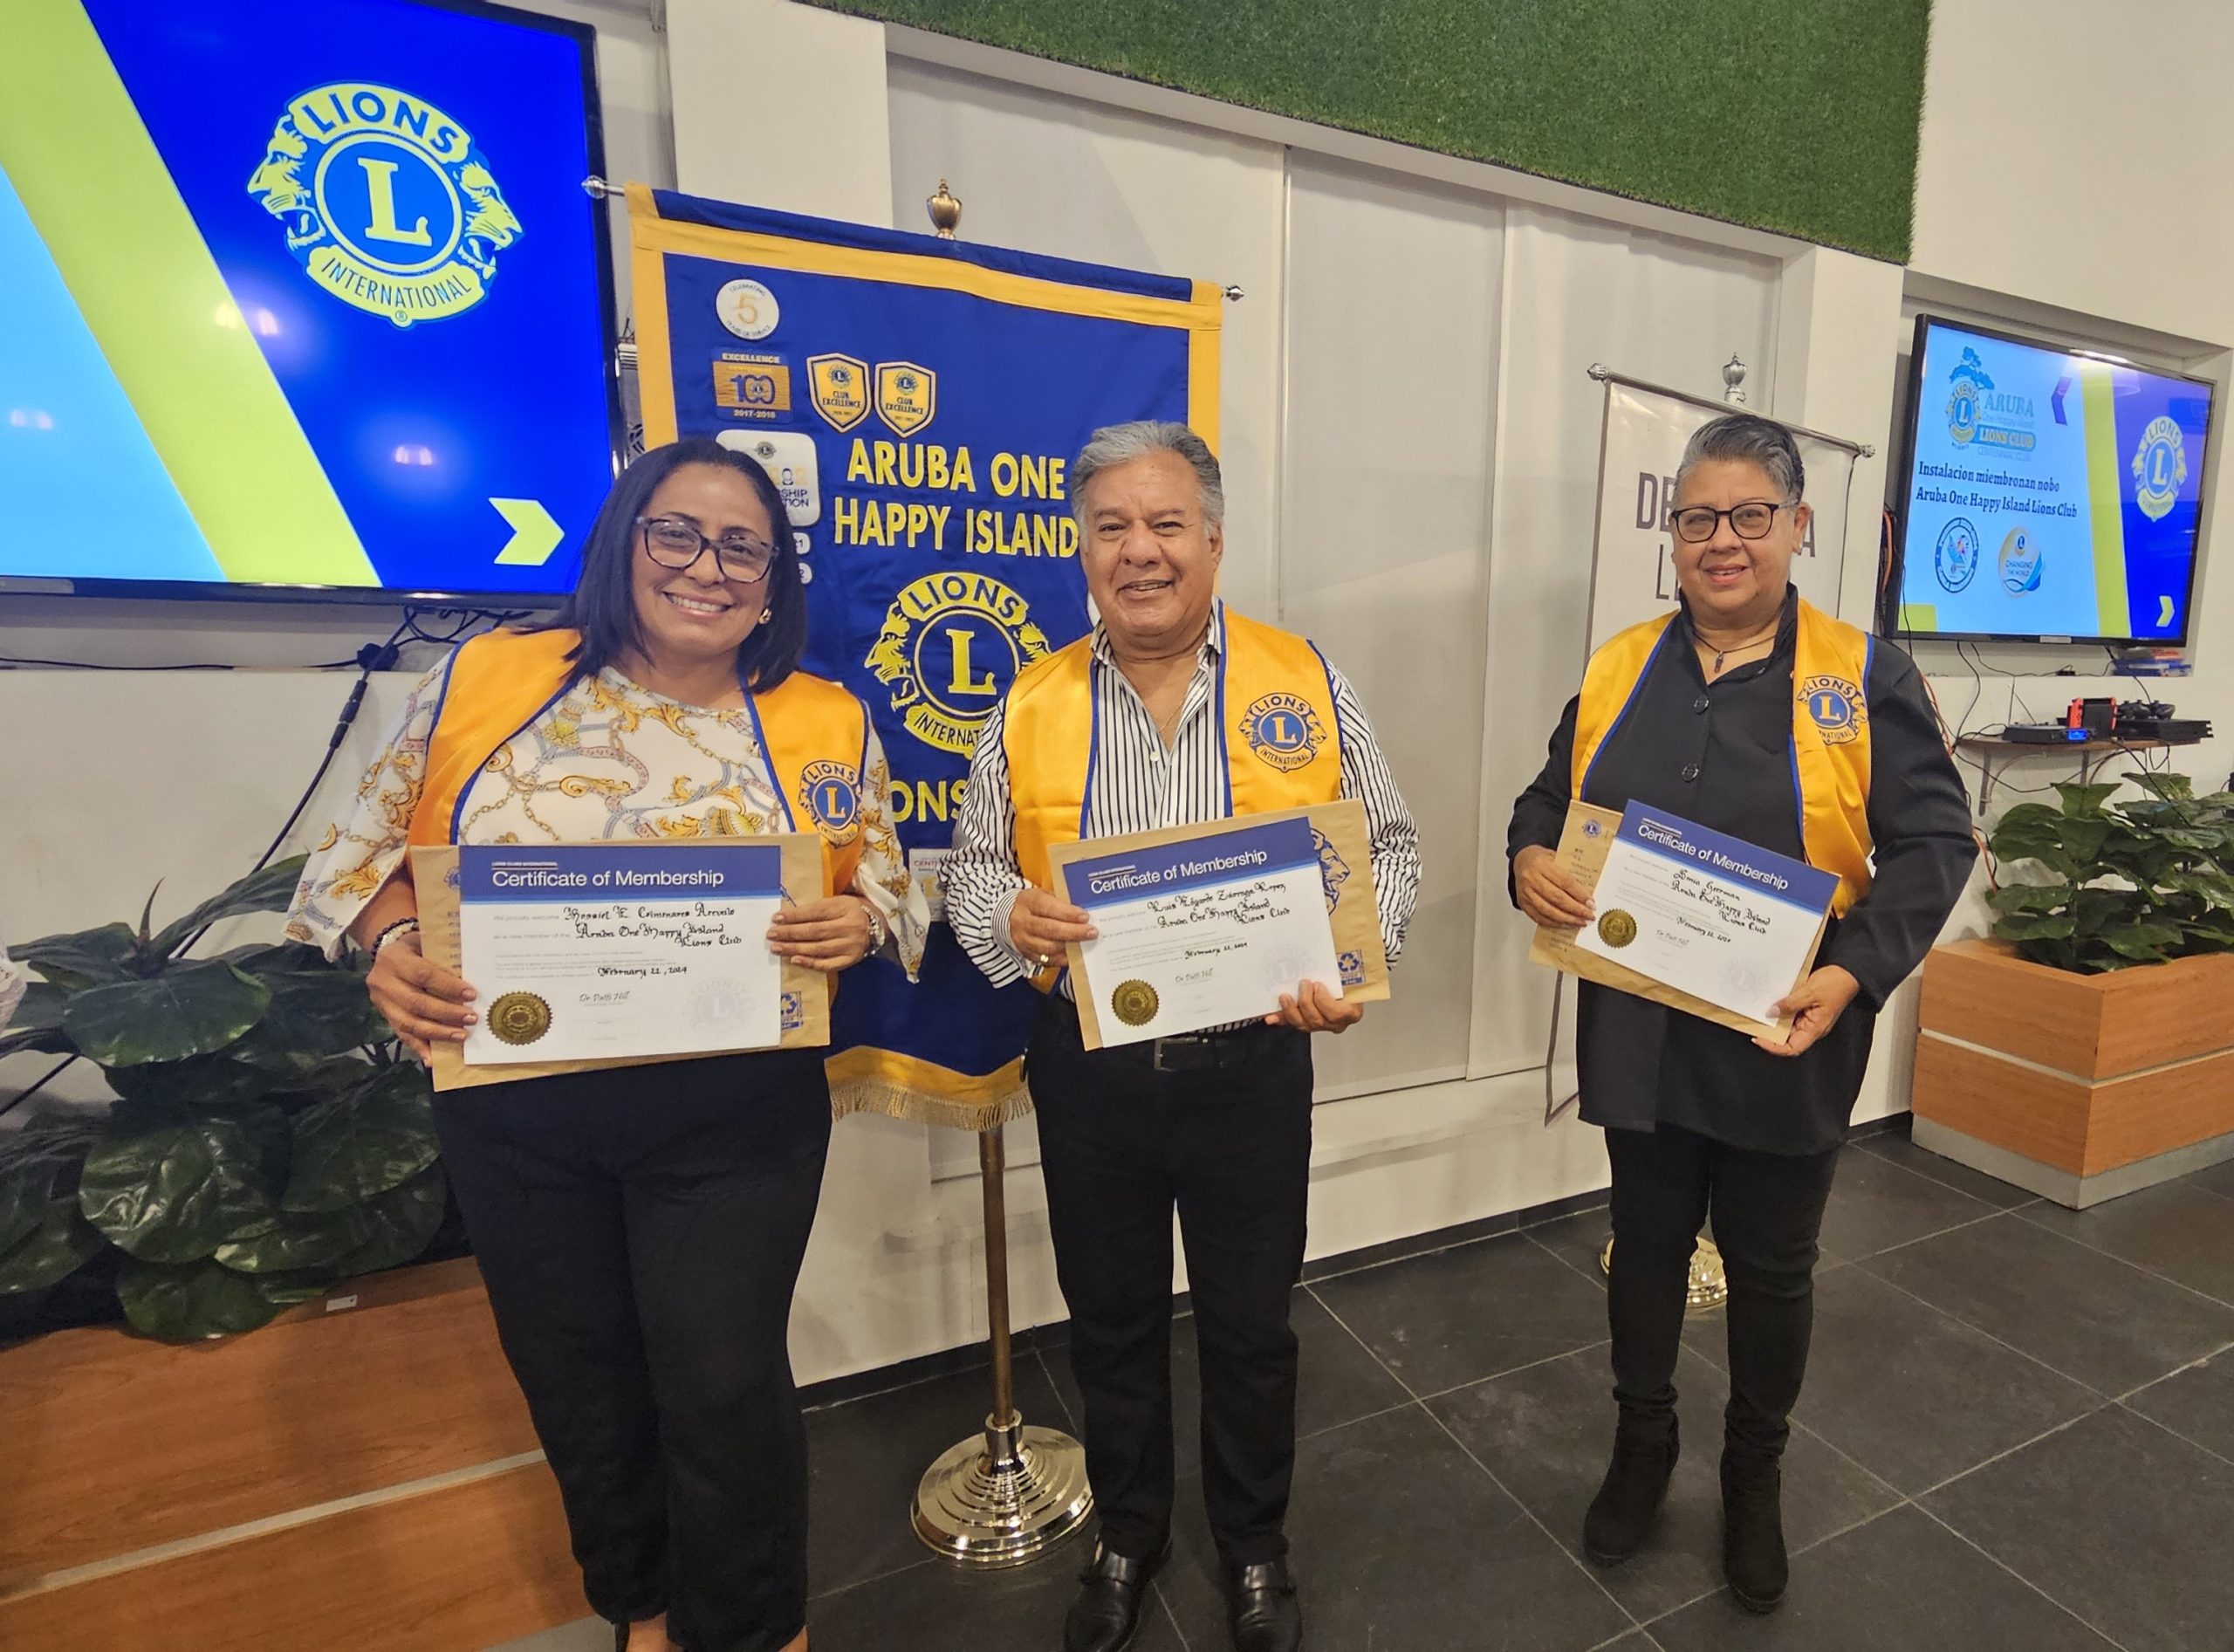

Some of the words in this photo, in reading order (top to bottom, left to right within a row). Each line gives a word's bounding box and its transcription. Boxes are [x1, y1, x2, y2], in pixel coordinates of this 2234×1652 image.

[302, 91, 459, 154] LIONS
[357, 157, 433, 247] L
[321, 257, 472, 309] INTERNATIONAL
[737, 293, 758, 324] 5
[722, 353, 780, 364] EXCELLENCE
[730, 374, 776, 405] 100
[822, 398, 860, 408] EXCELLENCE
[833, 390, 849, 399] CLUB
[886, 403, 924, 415] EXCELLENCE
[1984, 393, 2034, 417] ARUBA
[2149, 420, 2180, 444] LIONS
[846, 438, 977, 493] ARUBA
[991, 451, 1066, 500] ONE
[1918, 461, 1974, 482] Instalacion
[1976, 469, 2036, 490] miembronan
[2037, 477, 2060, 492] nobo
[2152, 449, 2168, 485] L
[781, 489, 808, 498] SHIP
[785, 498, 809, 507] TION
[1916, 486, 1947, 503] Aruba
[1950, 490, 1969, 506] One
[1970, 492, 2001, 513] Happy
[2002, 497, 2031, 513] Island
[2032, 500, 2056, 515] Lions
[2057, 503, 2077, 518] Club
[833, 497, 951, 551] HAPPY
[966, 508, 1080, 559] ISLAND
[908, 575, 1020, 620] LIONS
[946, 628, 997, 696] L
[1807, 678, 1854, 696] LIONS
[1255, 696, 1306, 713] LIONS
[1819, 696, 1841, 721] L
[914, 711, 980, 747] INTERNAT
[1272, 716, 1298, 744] L
[1260, 749, 1309, 765] INTERNATIONAL
[807, 764, 855, 782] LIONS
[825, 787, 846, 818] L
[889, 780, 969, 823] ONS
[1091, 870, 1161, 895] Certificate
[1163, 864, 1178, 881] of
[1180, 849, 1268, 877] Membership
[1638, 825, 1696, 856] Certificate
[1698, 849, 1713, 861] of
[1713, 852, 1789, 891] Membership
[492, 871, 587, 887] Certificate
[593, 870, 610, 887] of
[615, 869, 723, 888] Membership
[619, 926, 639, 937] One
[719, 934, 742, 946] Club
[598, 967, 647, 979] February
